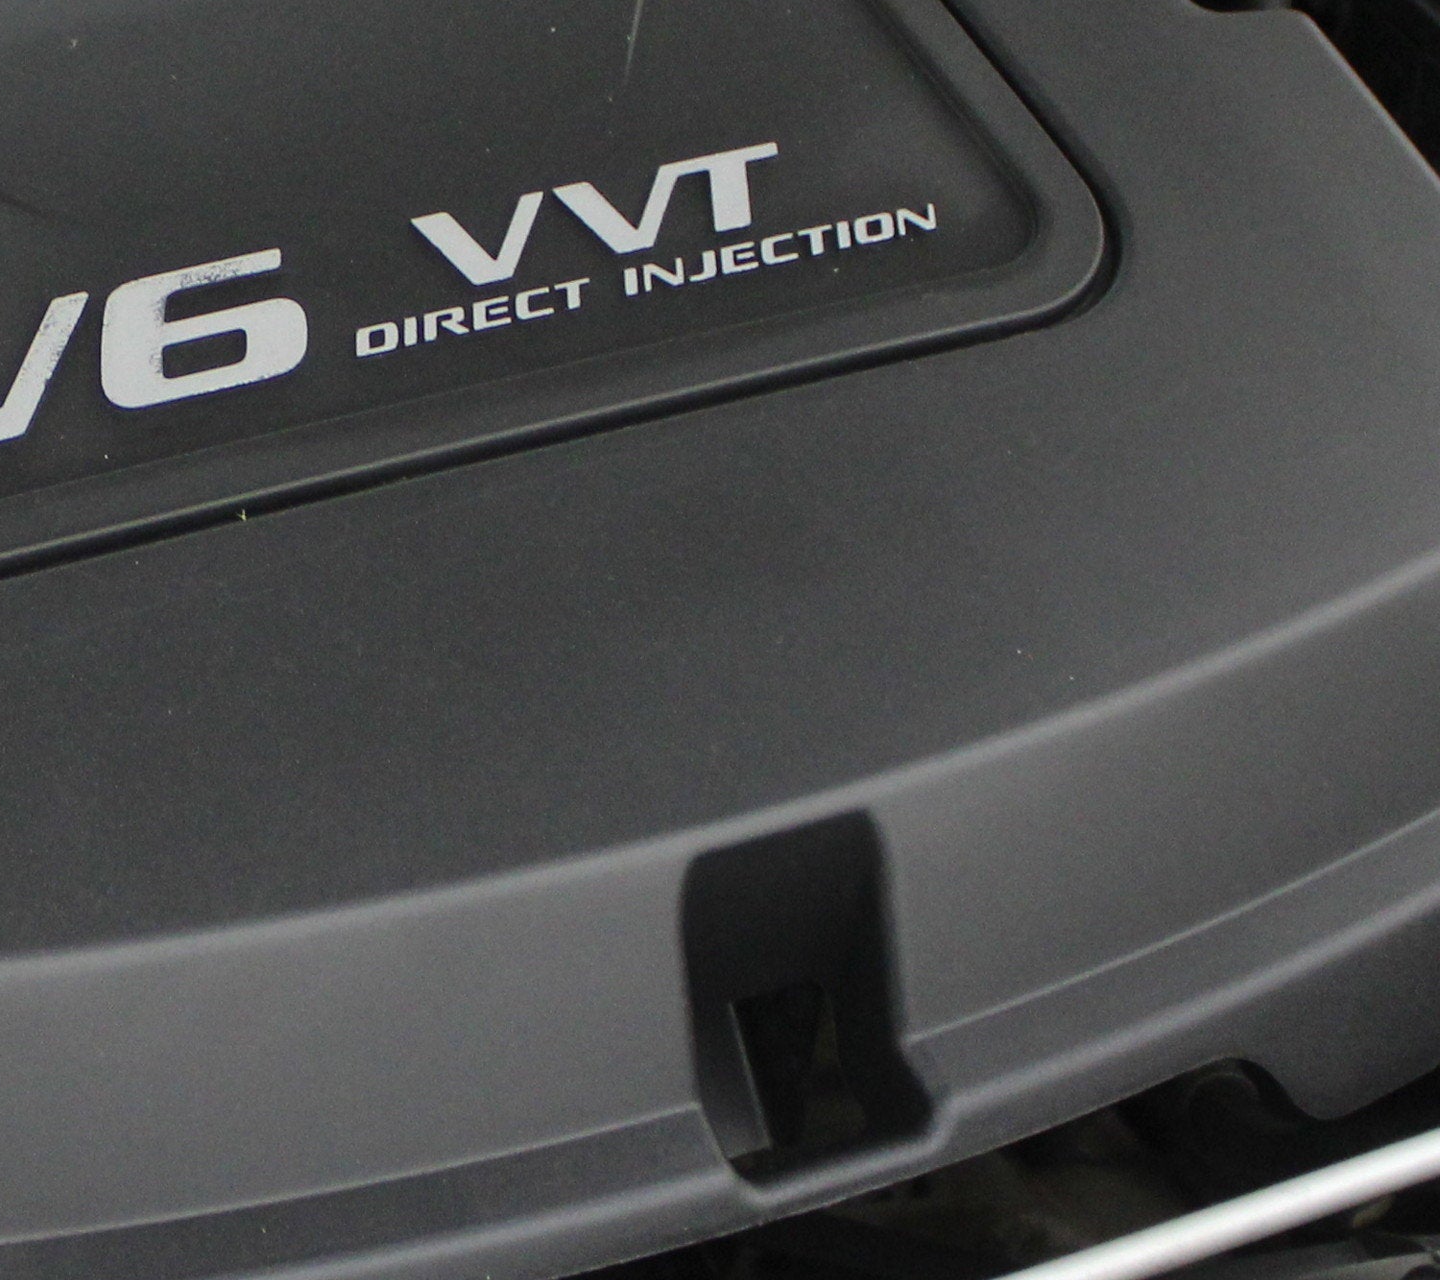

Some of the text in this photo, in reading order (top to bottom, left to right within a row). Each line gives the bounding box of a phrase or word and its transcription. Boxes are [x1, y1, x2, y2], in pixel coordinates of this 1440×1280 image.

[412, 142, 778, 285] VVT
[624, 203, 937, 296] INJECTION
[356, 277, 590, 357] DIRECT
